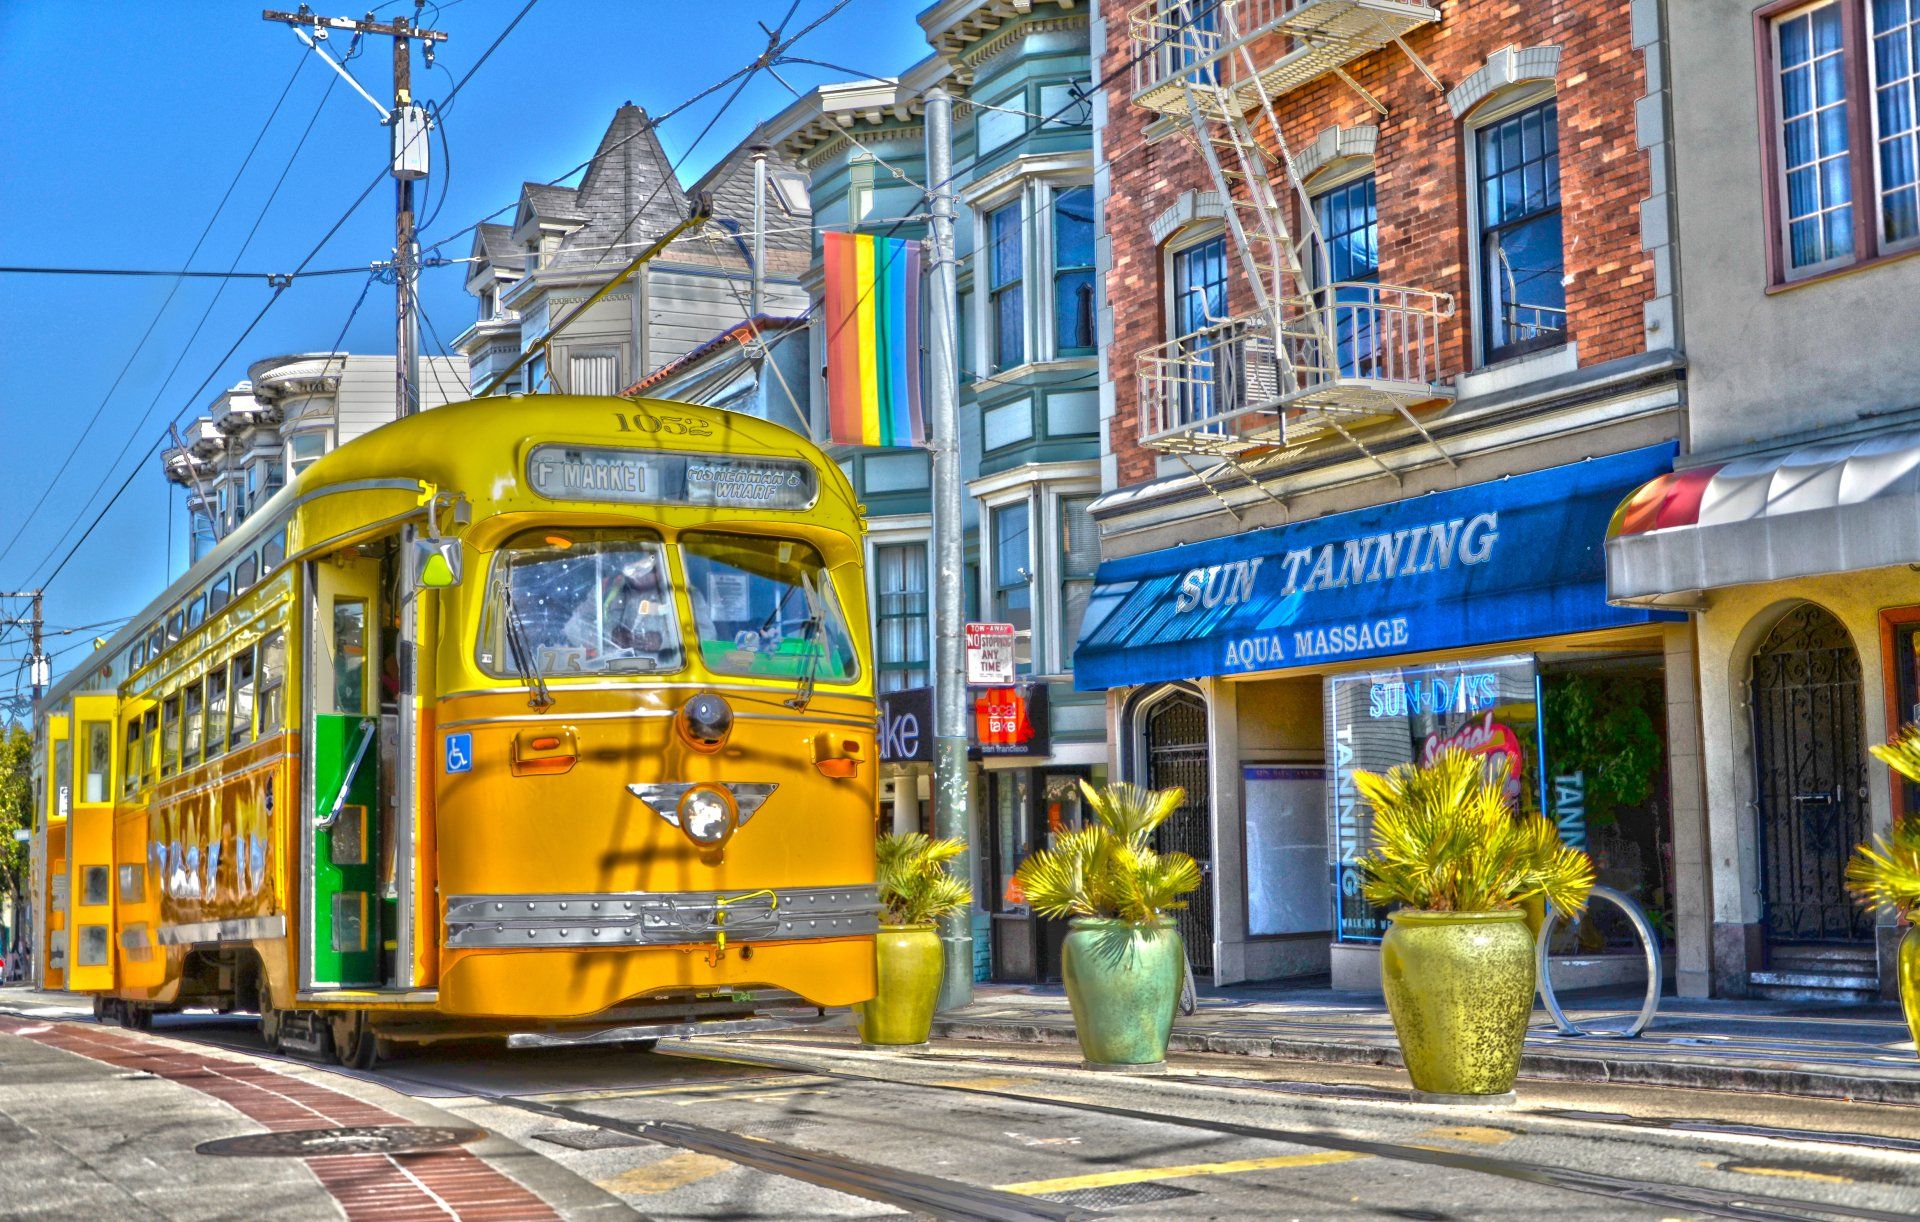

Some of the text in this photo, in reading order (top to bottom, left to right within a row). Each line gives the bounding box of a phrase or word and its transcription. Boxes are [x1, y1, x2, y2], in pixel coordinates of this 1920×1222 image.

[614, 412, 713, 437] 1052
[563, 461, 647, 493] MARKET
[716, 482, 776, 499] WHARF
[1176, 511, 1499, 613] SUN TANNING
[967, 634, 1011, 647] NO STOPPING
[1225, 617, 1409, 669] AQUA MASSAGE
[982, 650, 998, 659] ANY
[981, 662, 1000, 671] TIME
[988, 702, 1016, 716] local
[876, 701, 919, 758] ake
[990, 719, 1016, 732] take
[1337, 724, 1358, 897] TANNING
